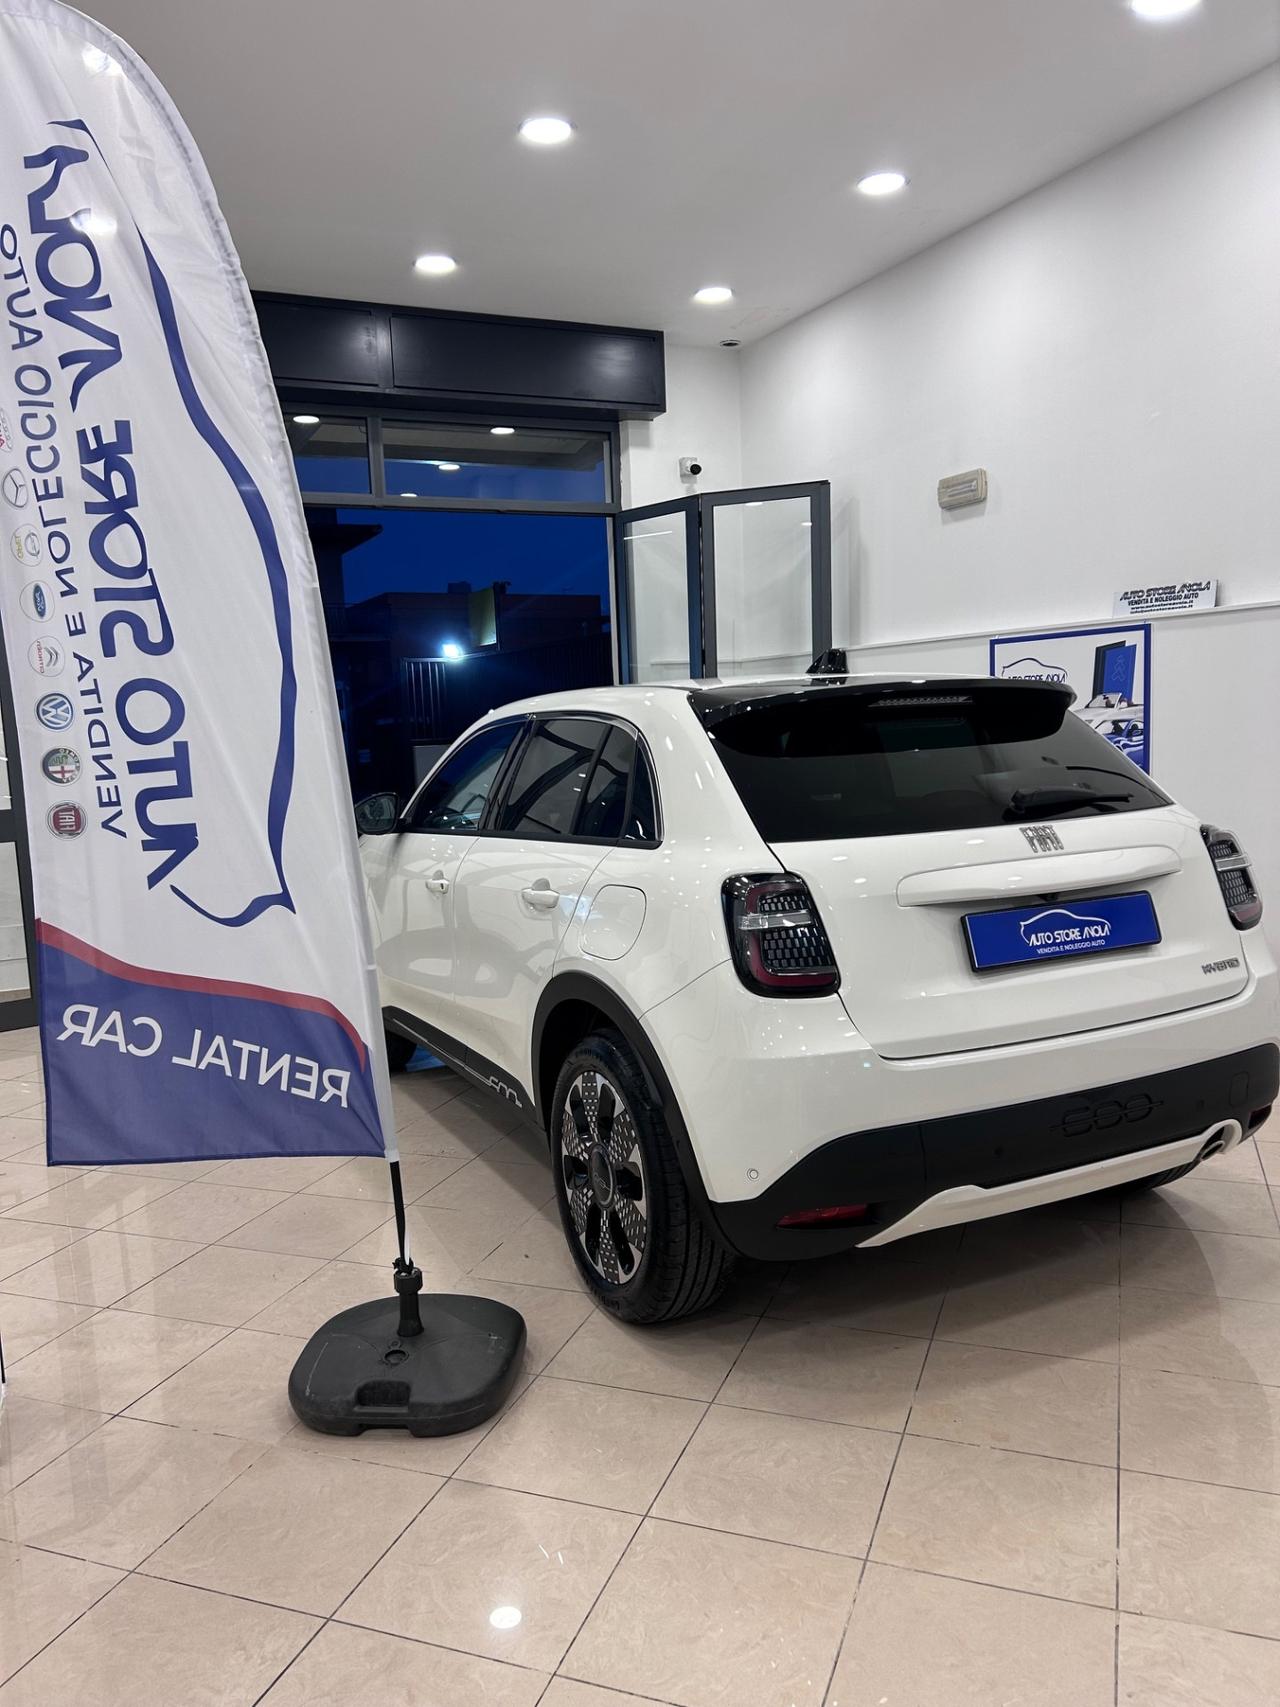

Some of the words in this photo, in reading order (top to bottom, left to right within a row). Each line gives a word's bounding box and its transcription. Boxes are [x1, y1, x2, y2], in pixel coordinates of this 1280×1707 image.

[1119, 590, 1145, 601] AUTO
[1146, 585, 1177, 598] STORE
[1128, 597, 1149, 606] VENDITA
[1155, 594, 1182, 603] NOLEGGIO
[1183, 592, 1199, 600] AUTO
[1019, 825, 1064, 854] FIAT
[1029, 933, 1054, 947] AUTO
[1055, 928, 1082, 943] STORE
[1036, 946, 1060, 954] VENDITA
[1064, 941, 1091, 951] NOLEGGIO
[1092, 939, 1105, 947] AUTO
